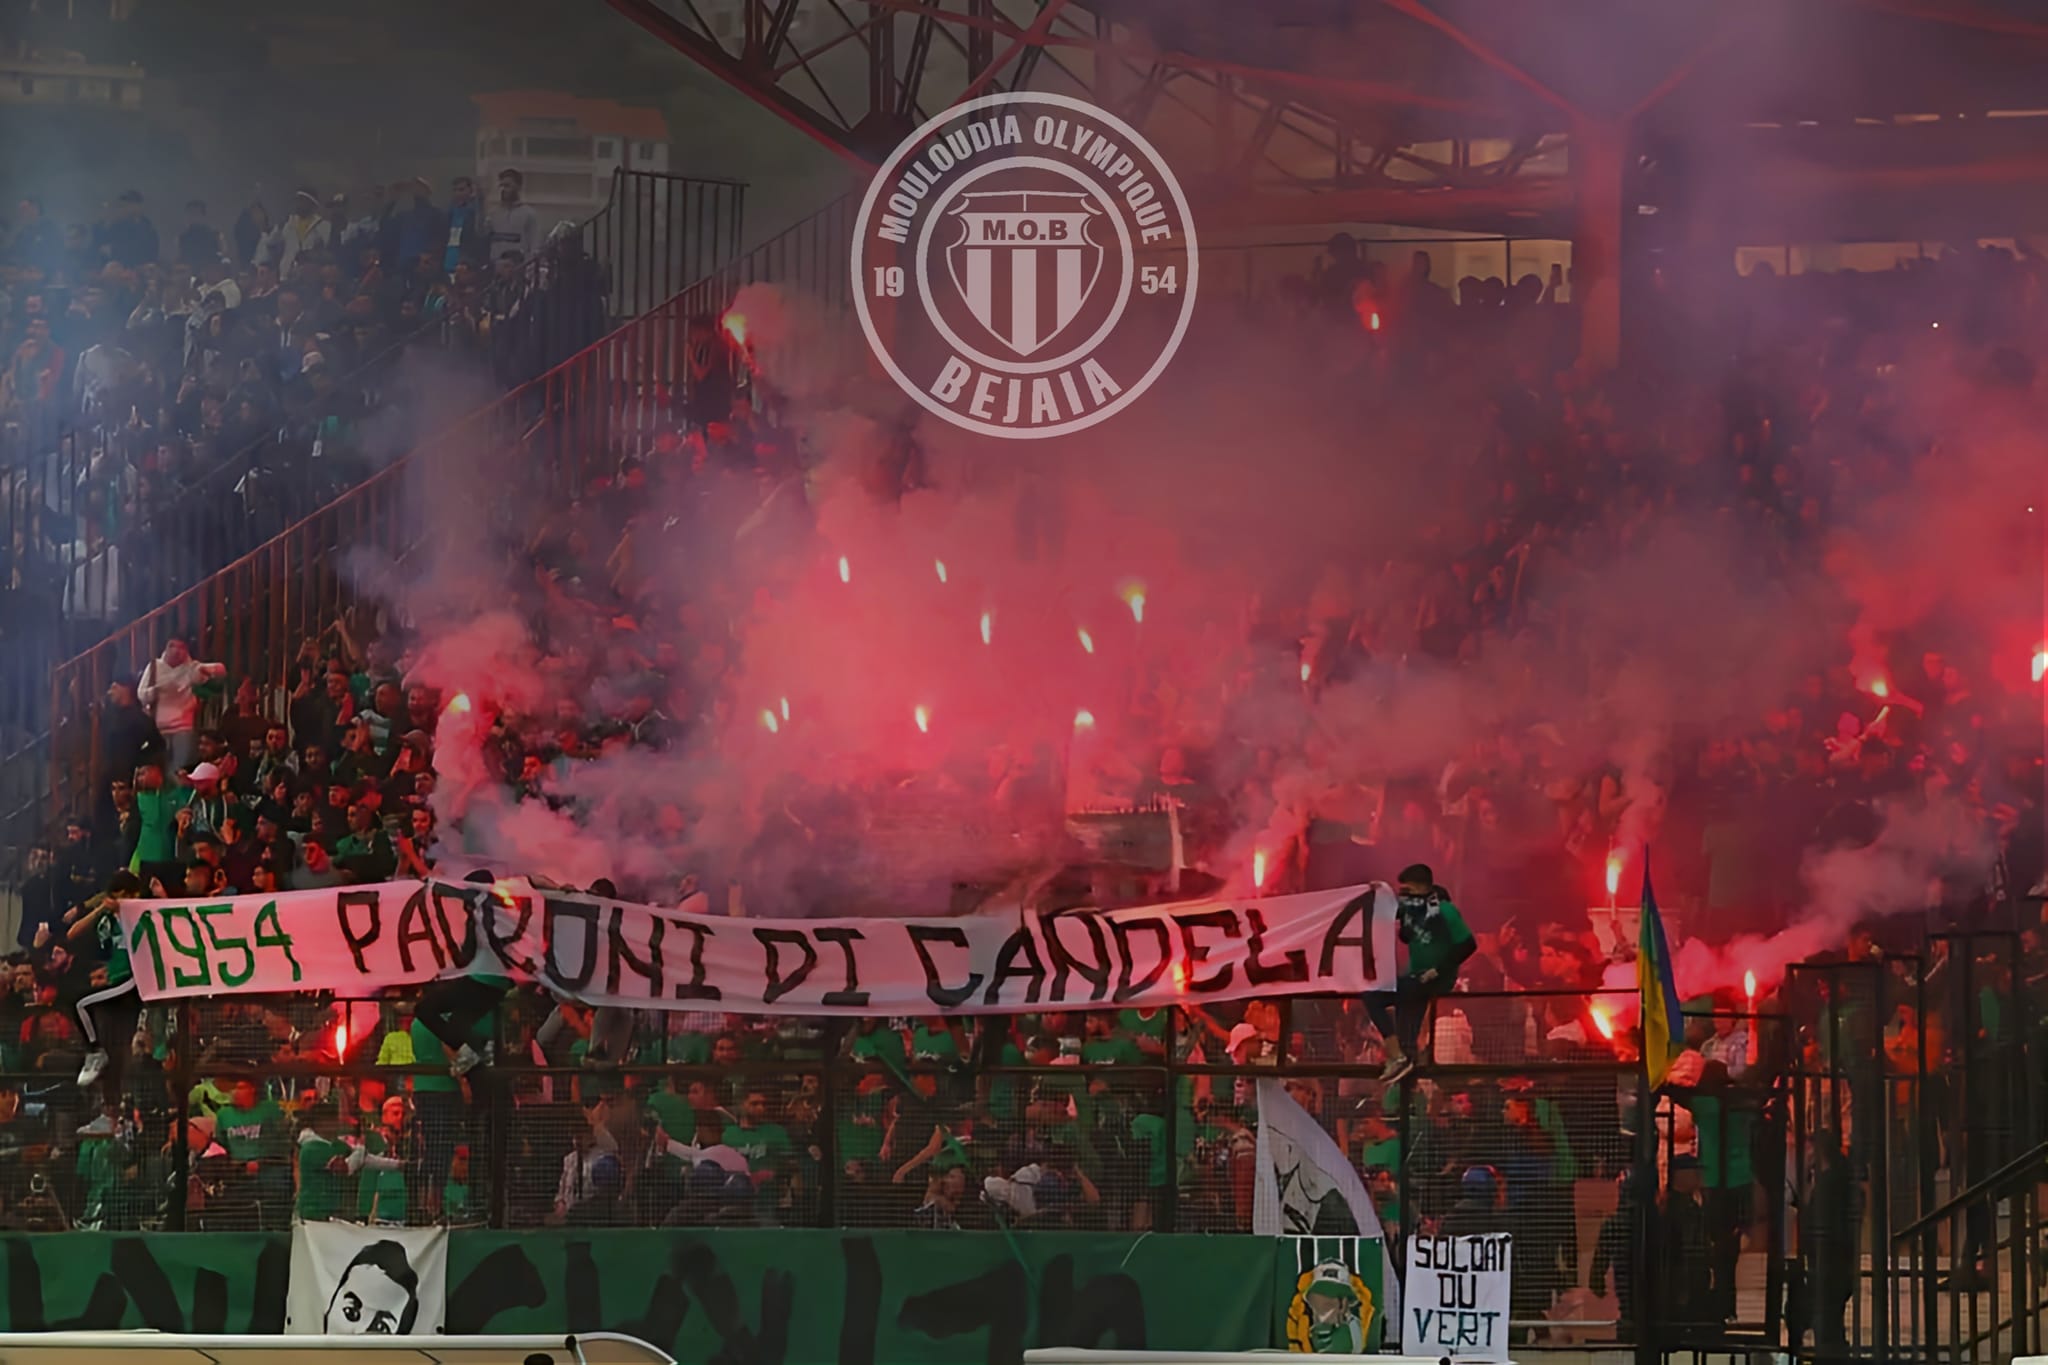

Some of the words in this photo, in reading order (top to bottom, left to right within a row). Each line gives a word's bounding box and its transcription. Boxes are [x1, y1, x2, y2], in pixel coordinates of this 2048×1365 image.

[131, 901, 301, 989] 1954
[337, 879, 722, 1001] PADRONI
[752, 928, 870, 1006] DI
[906, 883, 1378, 1008] CANDELA
[1415, 1234, 1512, 1272] SOLDAT
[1437, 1274, 1477, 1309] DU
[1413, 1308, 1501, 1346] VERT
